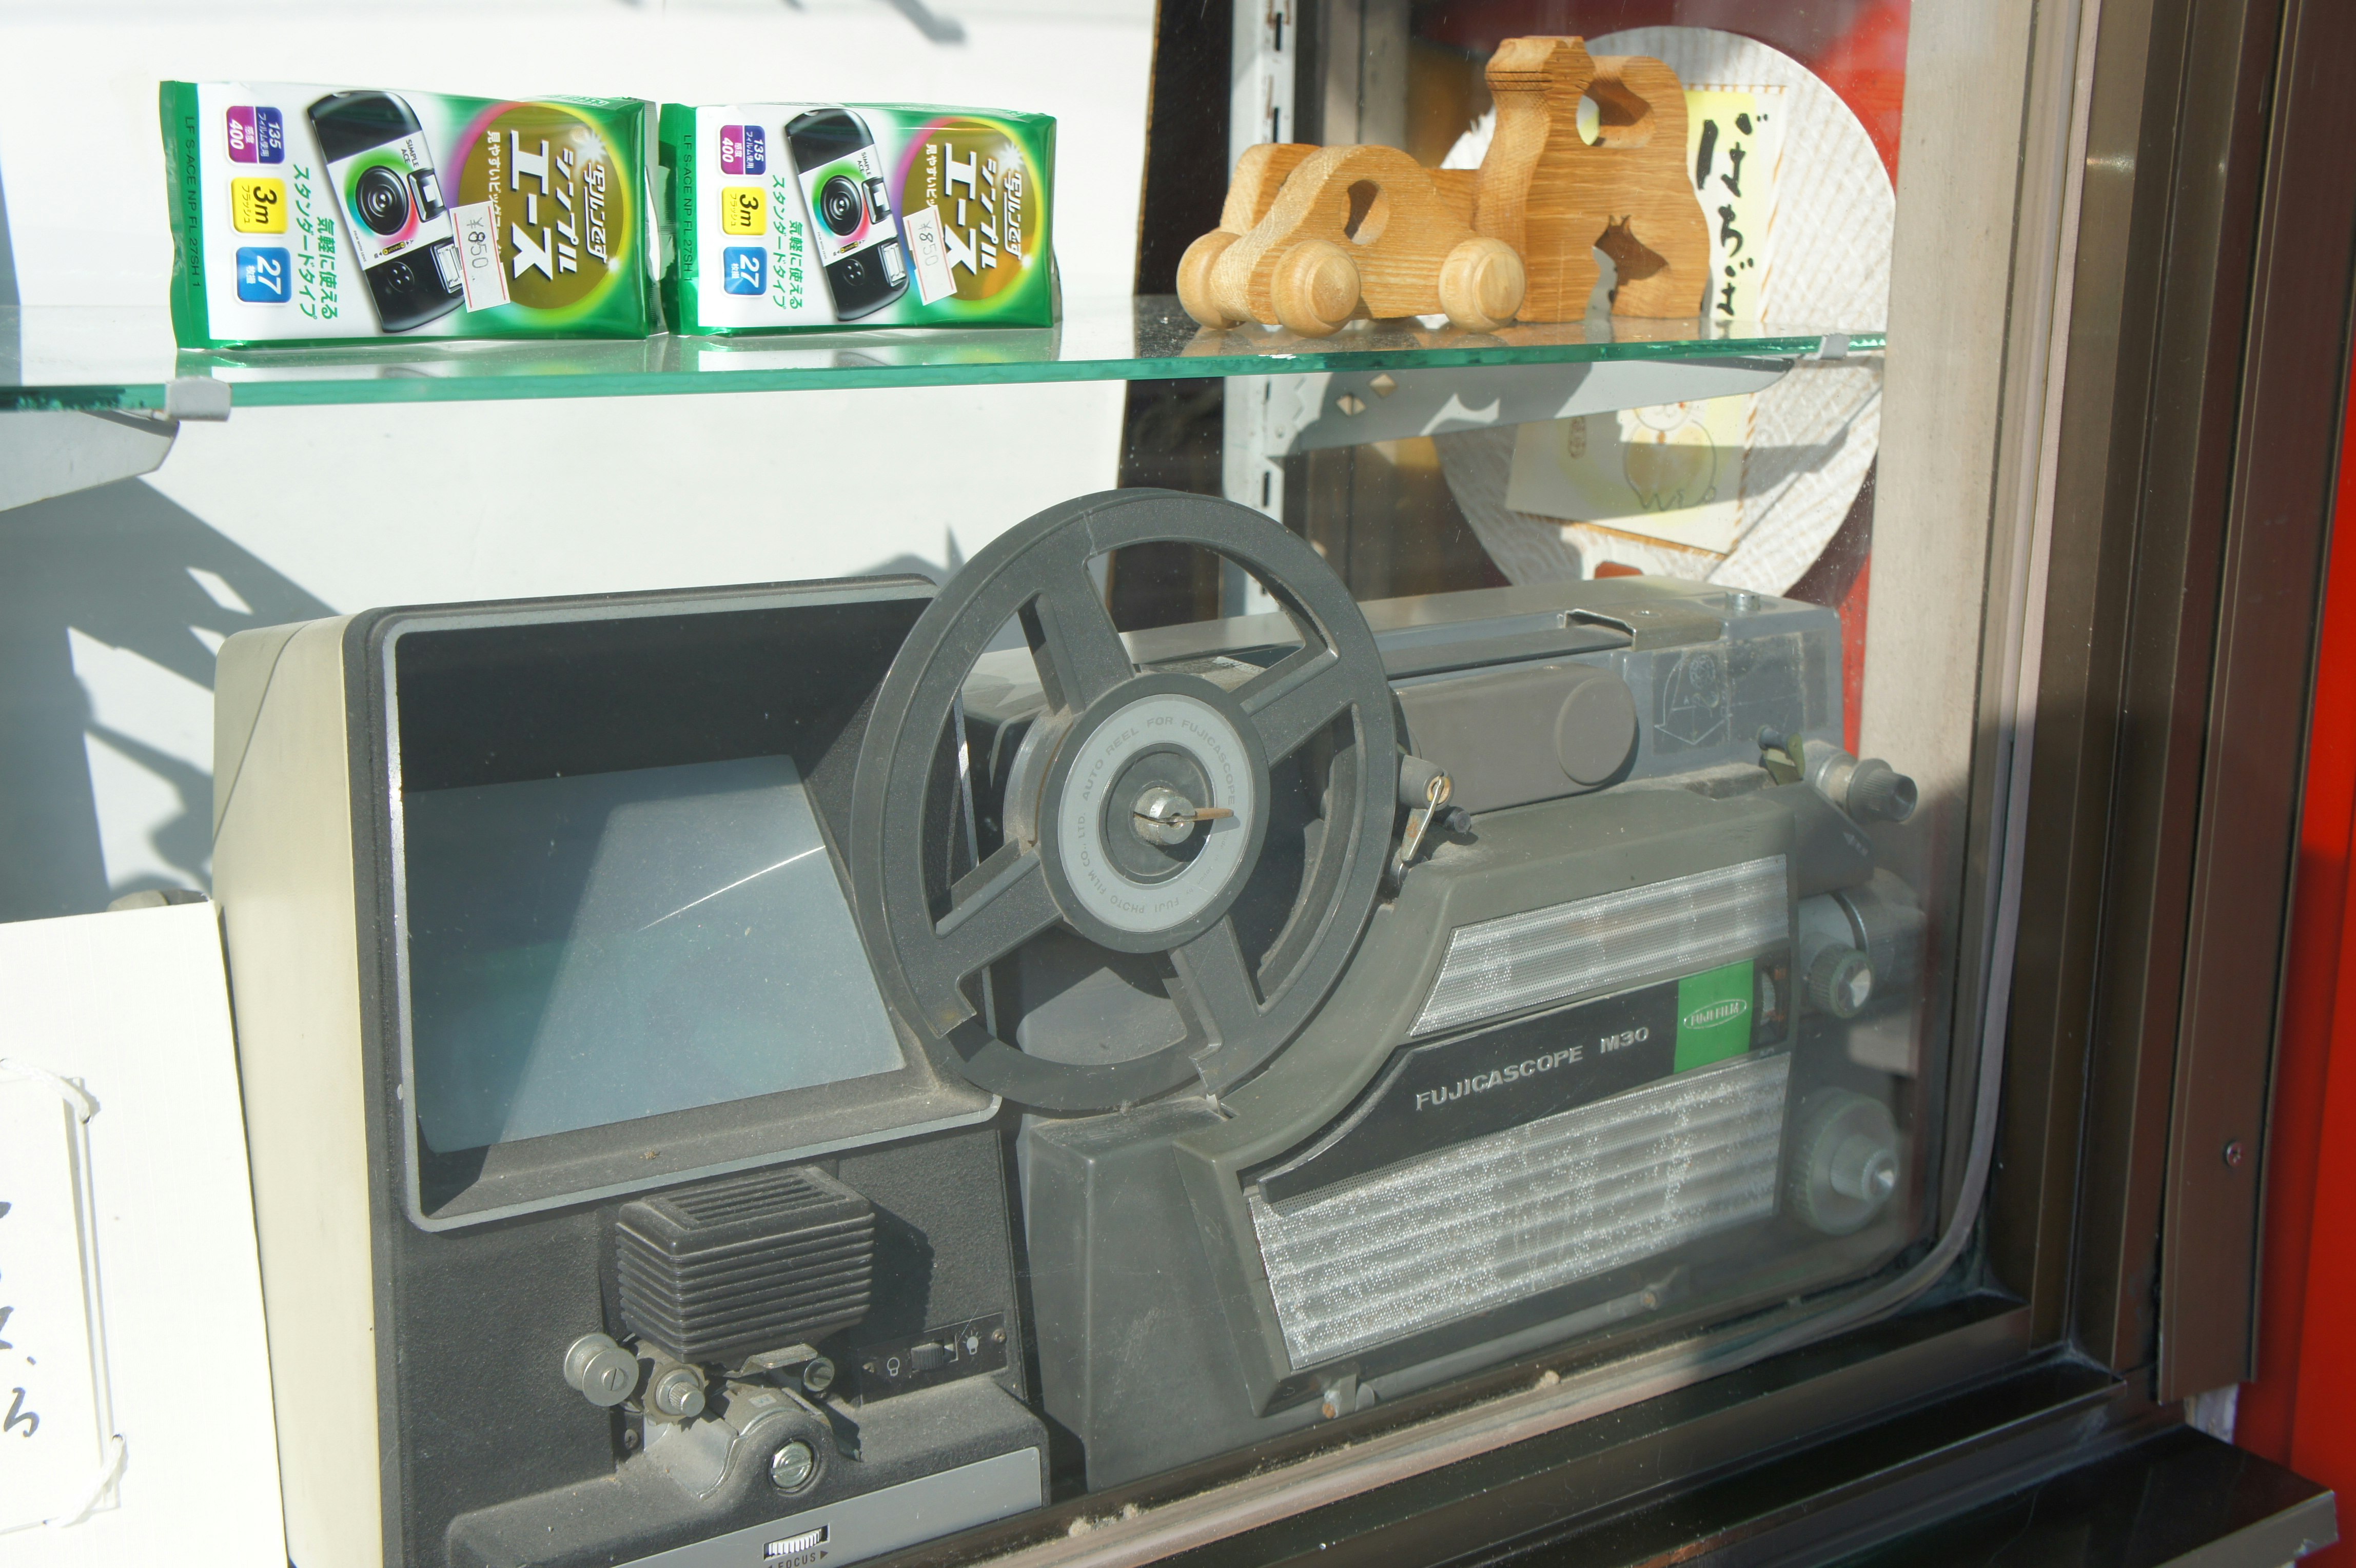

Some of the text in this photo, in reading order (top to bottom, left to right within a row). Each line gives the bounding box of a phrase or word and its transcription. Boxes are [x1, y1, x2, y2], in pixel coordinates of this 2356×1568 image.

[185, 116, 195, 135] LF
[229, 119, 244, 150] 400
[245, 125, 255, 144] 感度
[258, 112, 269, 157] フィルム使用
[268, 122, 281, 149] 135
[683, 134, 692, 150] LF
[186, 139, 197, 185] S-ACE
[401, 149, 410, 165] ACE
[406, 139, 419, 168] SIMPLE
[721, 137, 734, 163] 400
[734, 143, 742, 158] 感度
[754, 139, 764, 161] 135
[861, 152, 872, 175] SIMPLE
[683, 154, 692, 195] S-ACE
[187, 191, 197, 211] NP
[242, 185, 251, 225] フラッシュ
[253, 186, 278, 225] 3m
[511, 129, 553, 281] エース
[556, 148, 579, 274] シンプル
[583, 162, 608, 264] 写ルンです
[684, 199, 692, 217] NP
[740, 193, 759, 227] 3m
[945, 143, 977, 276] エース
[980, 158, 997, 269] シンプル
[1004, 171, 1022, 260] 写ルンです
[188, 217, 198, 233] FL
[293, 164, 318, 320] スタンダードタイプ
[684, 220, 692, 236] FL
[190, 238, 200, 276] 27SH
[467, 217, 489, 268] ¥850
[683, 240, 692, 272] 27SH
[772, 175, 786, 310] スタンダードタイプ
[918, 223, 939, 267] ¥850
[246, 265, 255, 284] 枚撮
[257, 255, 281, 295] 27
[318, 217, 338, 319] 気軽に使える
[739, 253, 760, 288] 27
[789, 220, 803, 309] 気軽に使える
[1082, 716, 1235, 806] AUTO REEL FOR FUJICASCOPE
[1087, 870, 1107, 895] FILM
[1110, 895, 1145, 914] PHOTO
[1154, 896, 1180, 913] FUJI
[1415, 1027, 1650, 1111] FUJICASCOPE M30
[778, 1552, 816, 1568] FOCUS
